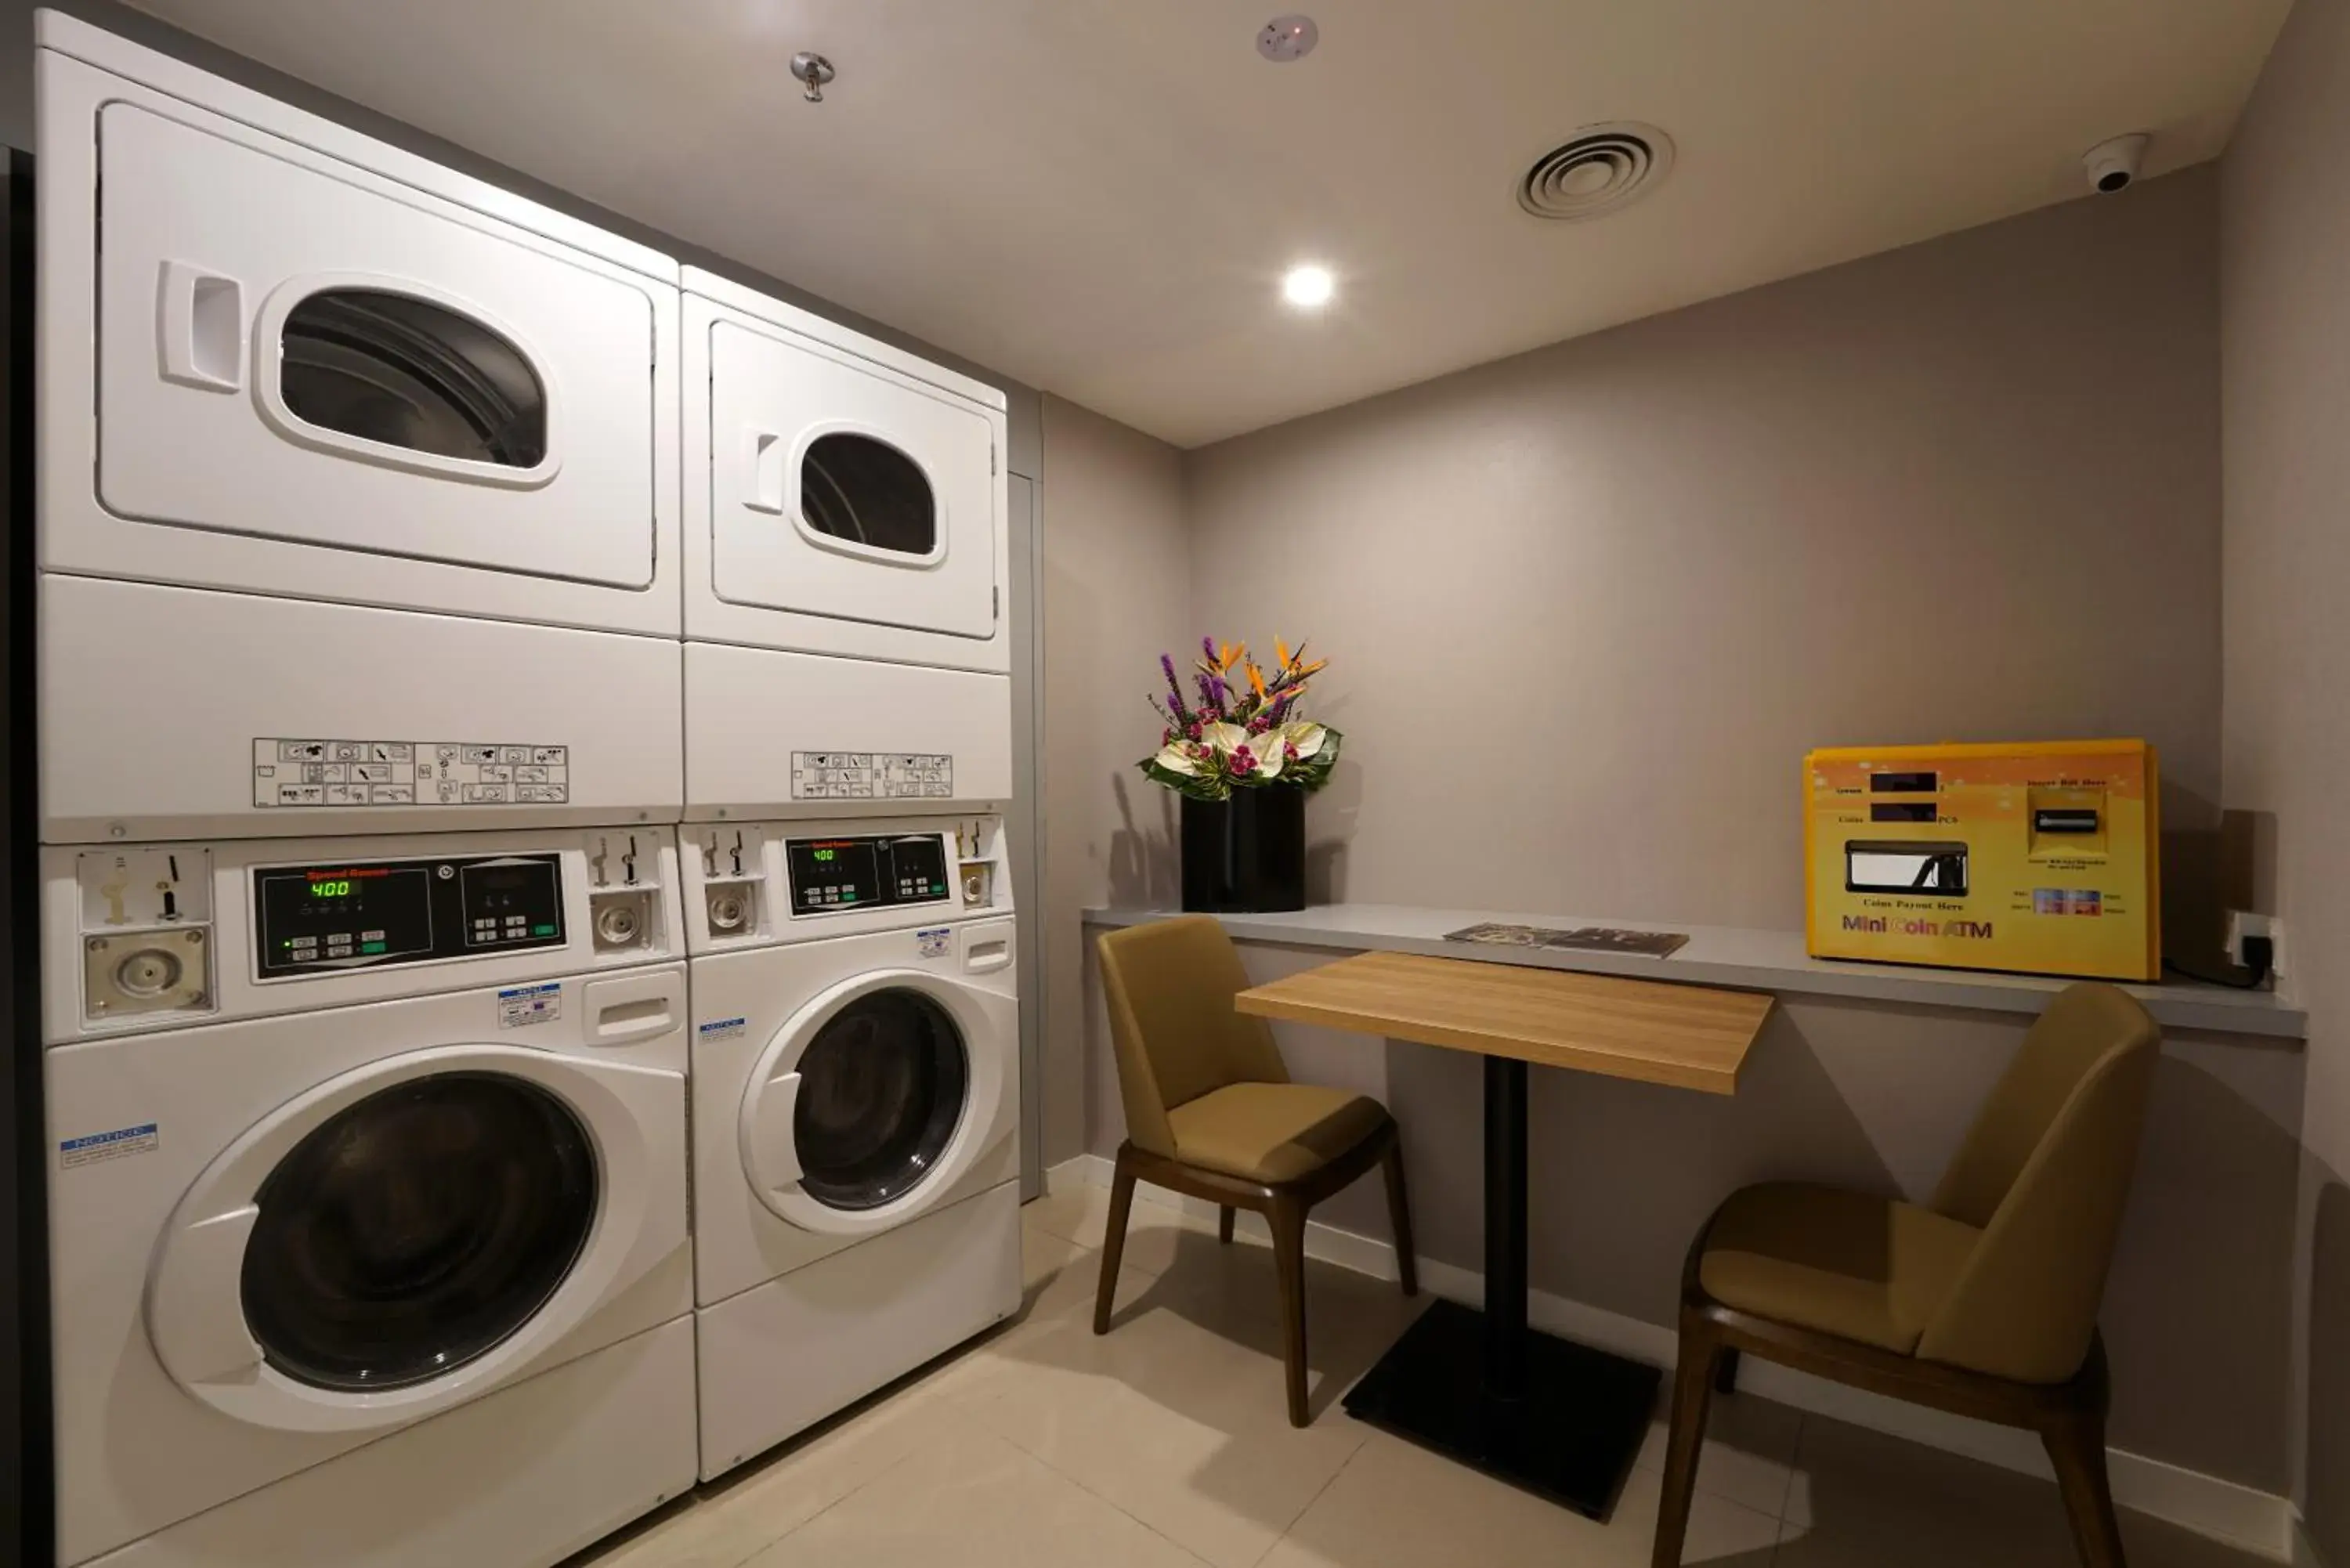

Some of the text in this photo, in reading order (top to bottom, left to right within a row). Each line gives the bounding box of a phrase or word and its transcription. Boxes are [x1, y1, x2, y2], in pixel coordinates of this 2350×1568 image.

[815, 850, 833, 860] 400
[312, 881, 349, 896] 400
[1896, 901, 1933, 909] Payout
[1938, 902, 1964, 911] Here
[1842, 915, 1993, 938] Mini Coin ATM
